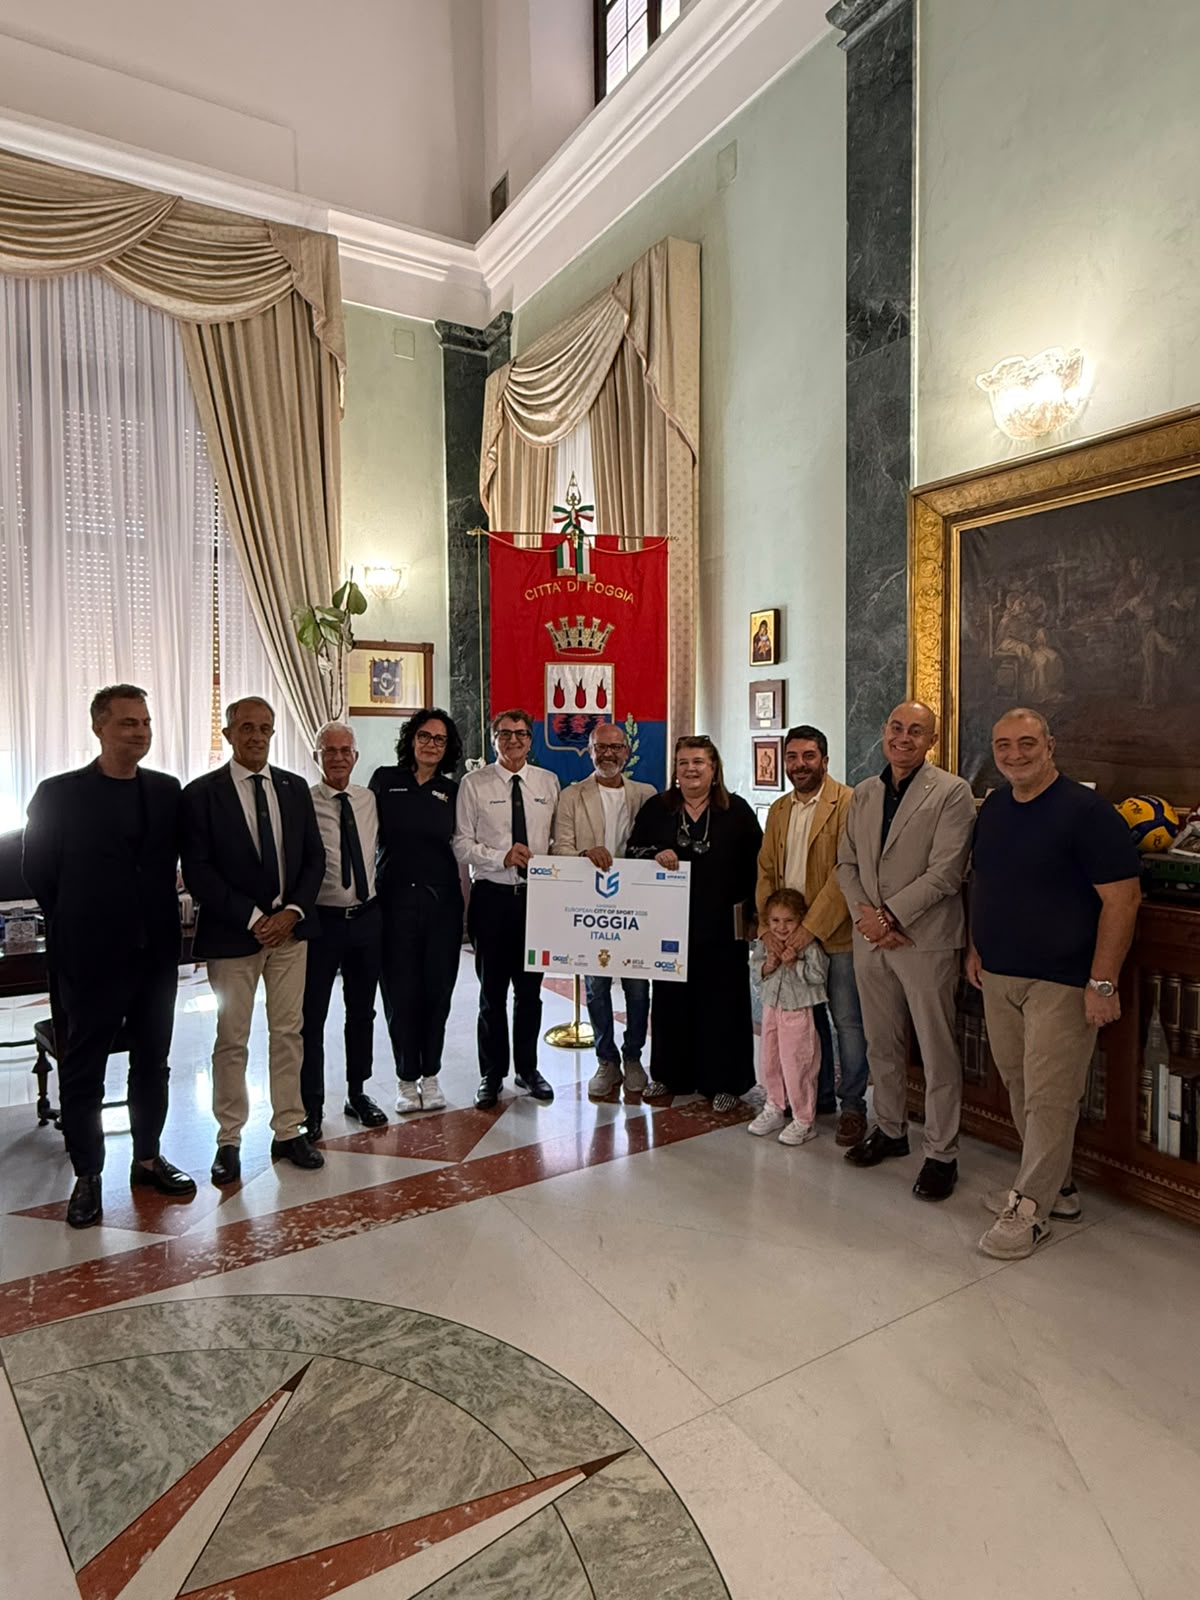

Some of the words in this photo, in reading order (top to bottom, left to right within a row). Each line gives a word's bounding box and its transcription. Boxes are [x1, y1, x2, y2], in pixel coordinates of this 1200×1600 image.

[566, 580, 580, 592] DI
[586, 581, 634, 604] FOGGIA
[573, 914, 639, 930] FOGGIA
[590, 931, 621, 941] ITALIA
